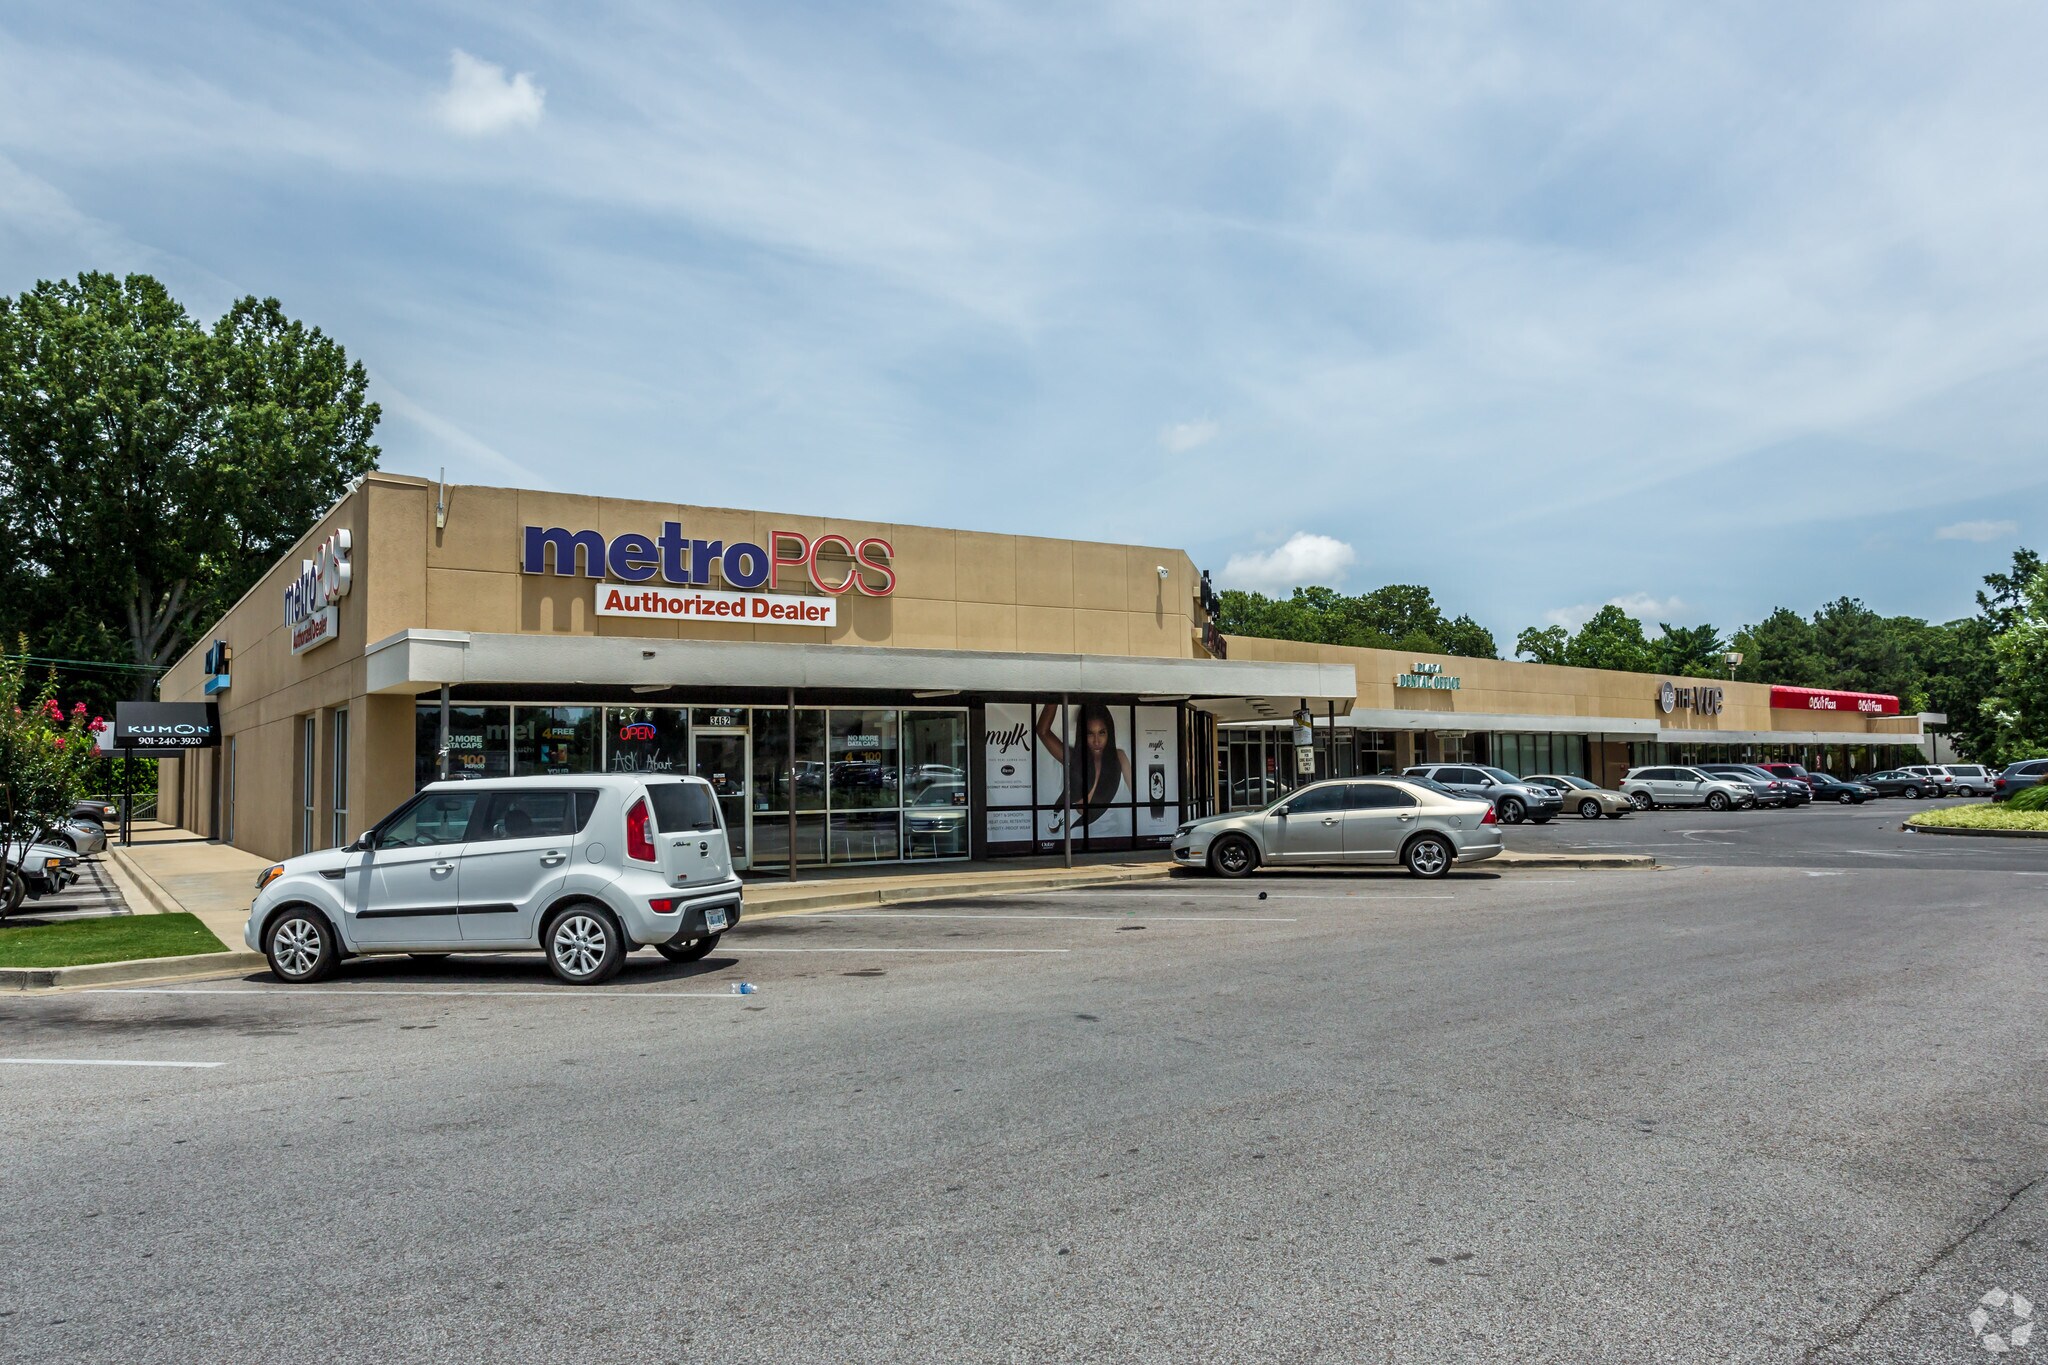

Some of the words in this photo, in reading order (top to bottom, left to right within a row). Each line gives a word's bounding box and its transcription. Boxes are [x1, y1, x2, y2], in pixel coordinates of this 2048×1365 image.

[523, 521, 897, 597] metroPCS
[604, 589, 746, 618] Authorized
[752, 596, 831, 622] Dealer
[1415, 663, 1443, 674] PLAZA
[1399, 674, 1432, 688] DENTAL
[1433, 676, 1461, 690] OFFICE
[710, 716, 731, 726] 3462
[128, 724, 210, 735] KUMON
[542, 728, 552, 739] 4
[619, 725, 655, 741] OPEN
[138, 737, 202, 745] 901-240-3920
[455, 735, 483, 743] MORE
[986, 723, 1030, 754] mylk
[1148, 740, 1164, 751] mylk
